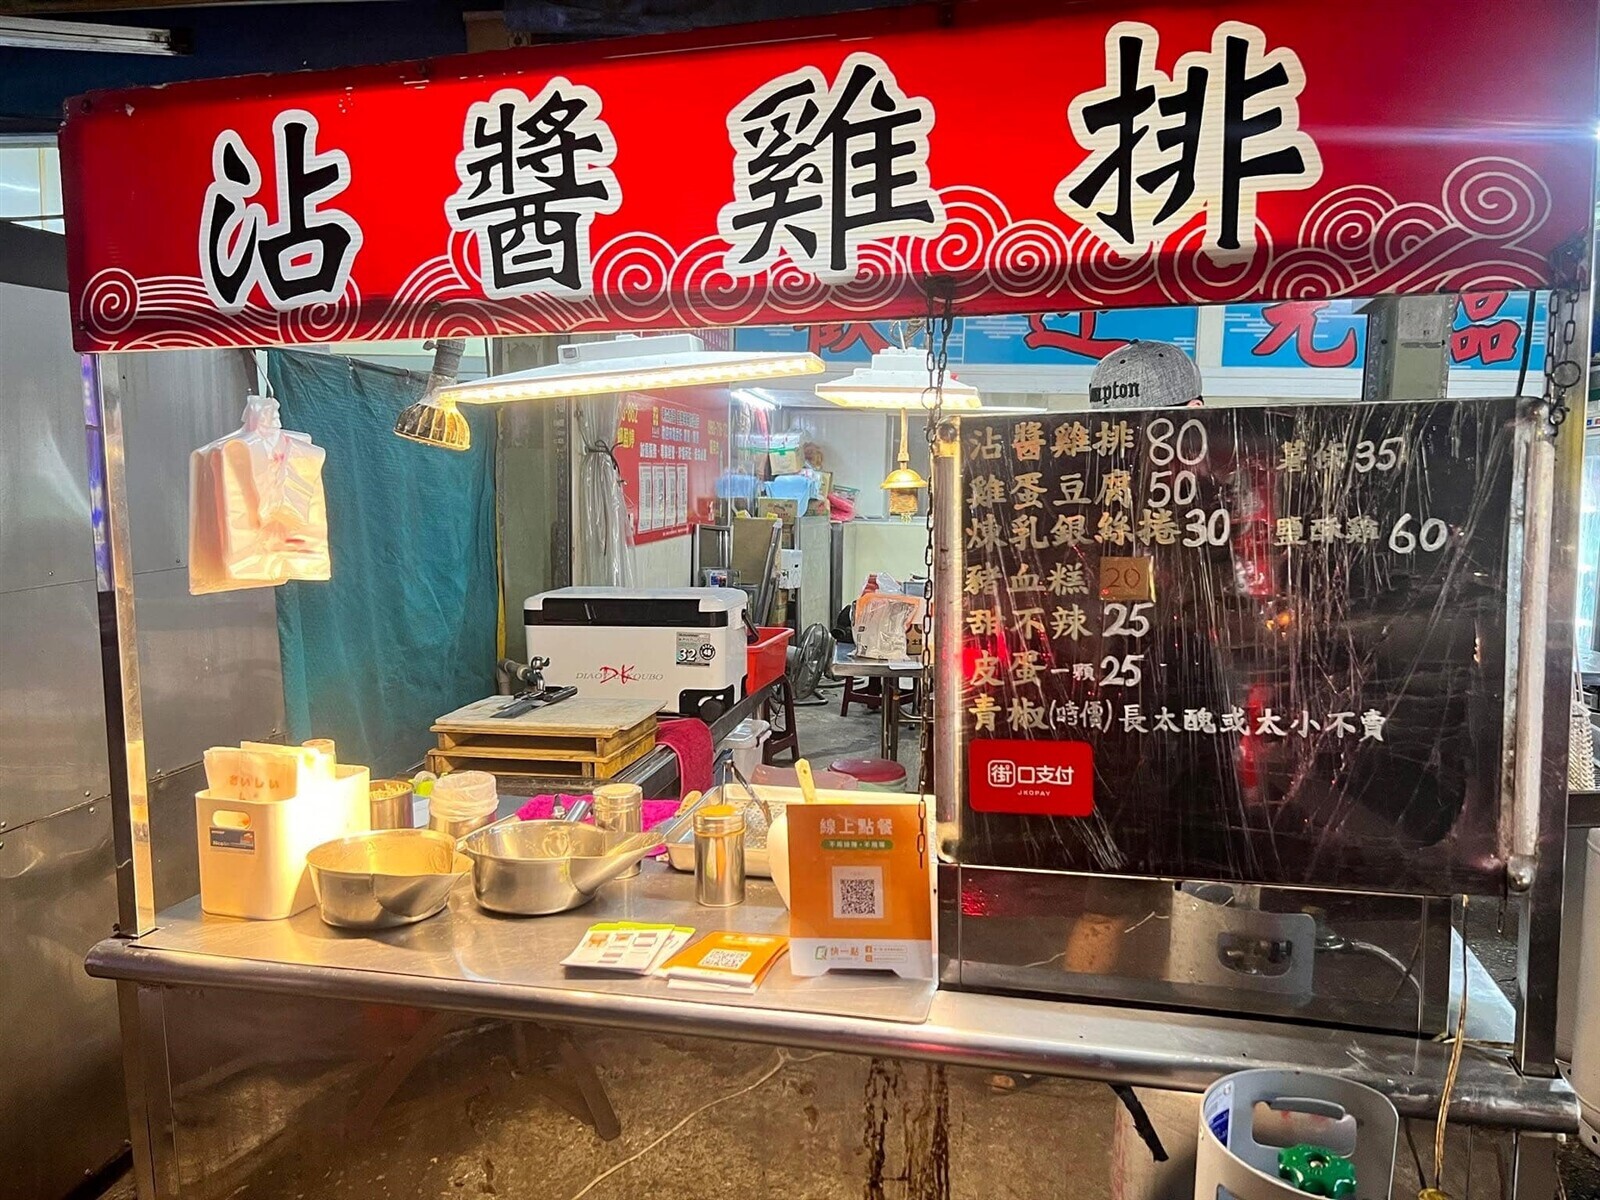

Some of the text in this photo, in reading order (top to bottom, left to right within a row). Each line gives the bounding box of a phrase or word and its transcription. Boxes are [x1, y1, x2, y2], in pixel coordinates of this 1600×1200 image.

[204, 30, 1310, 307] 沾醬雞排
[969, 417, 1208, 466] 沾醬雞排 80
[1354, 436, 1404, 473] 35
[965, 468, 1197, 511] 雞蛋豆腐 50
[1182, 508, 1231, 549] 30
[1388, 512, 1449, 554] 60
[963, 562, 1142, 597] 豬血糕 20
[966, 602, 1155, 642] 甜不辣 25
[677, 647, 698, 662] 32
[1098, 654, 1145, 688] 25
[987, 759, 1075, 787] 街口支付
[819, 817, 894, 836] 線上點餐
